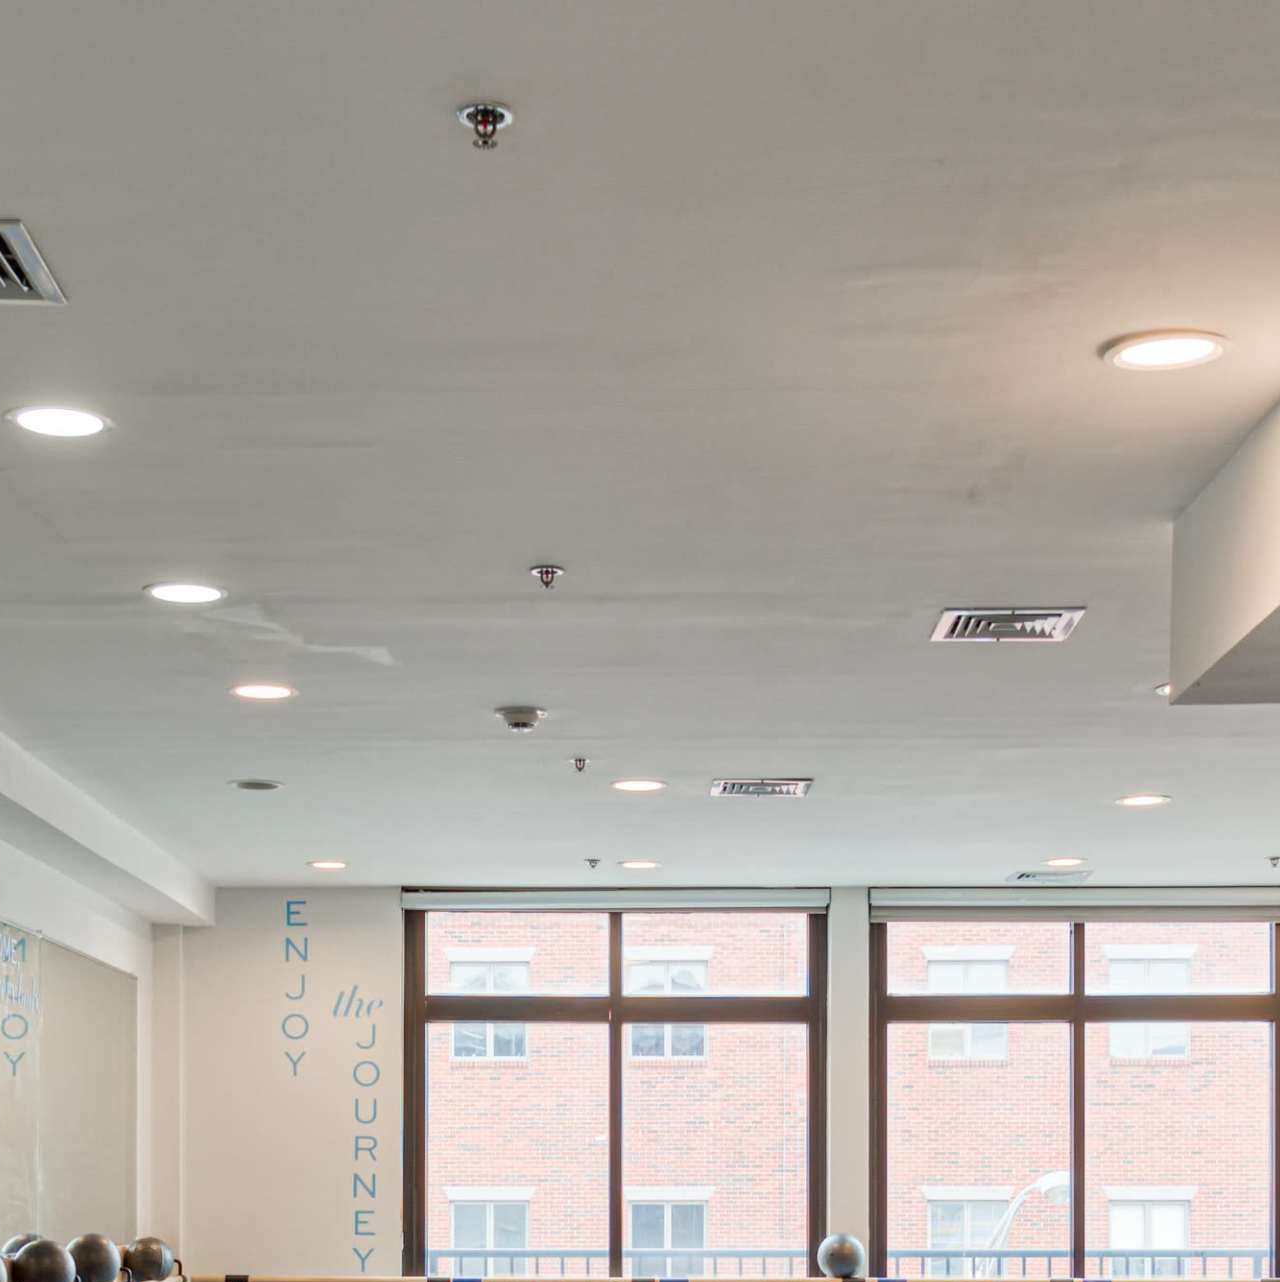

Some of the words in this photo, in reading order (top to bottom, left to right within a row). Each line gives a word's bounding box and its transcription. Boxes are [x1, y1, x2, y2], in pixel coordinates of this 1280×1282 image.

[282, 900, 310, 1078] ENJOY
[333, 984, 385, 1019] the
[352, 1024, 381, 1273] JOURNEY
